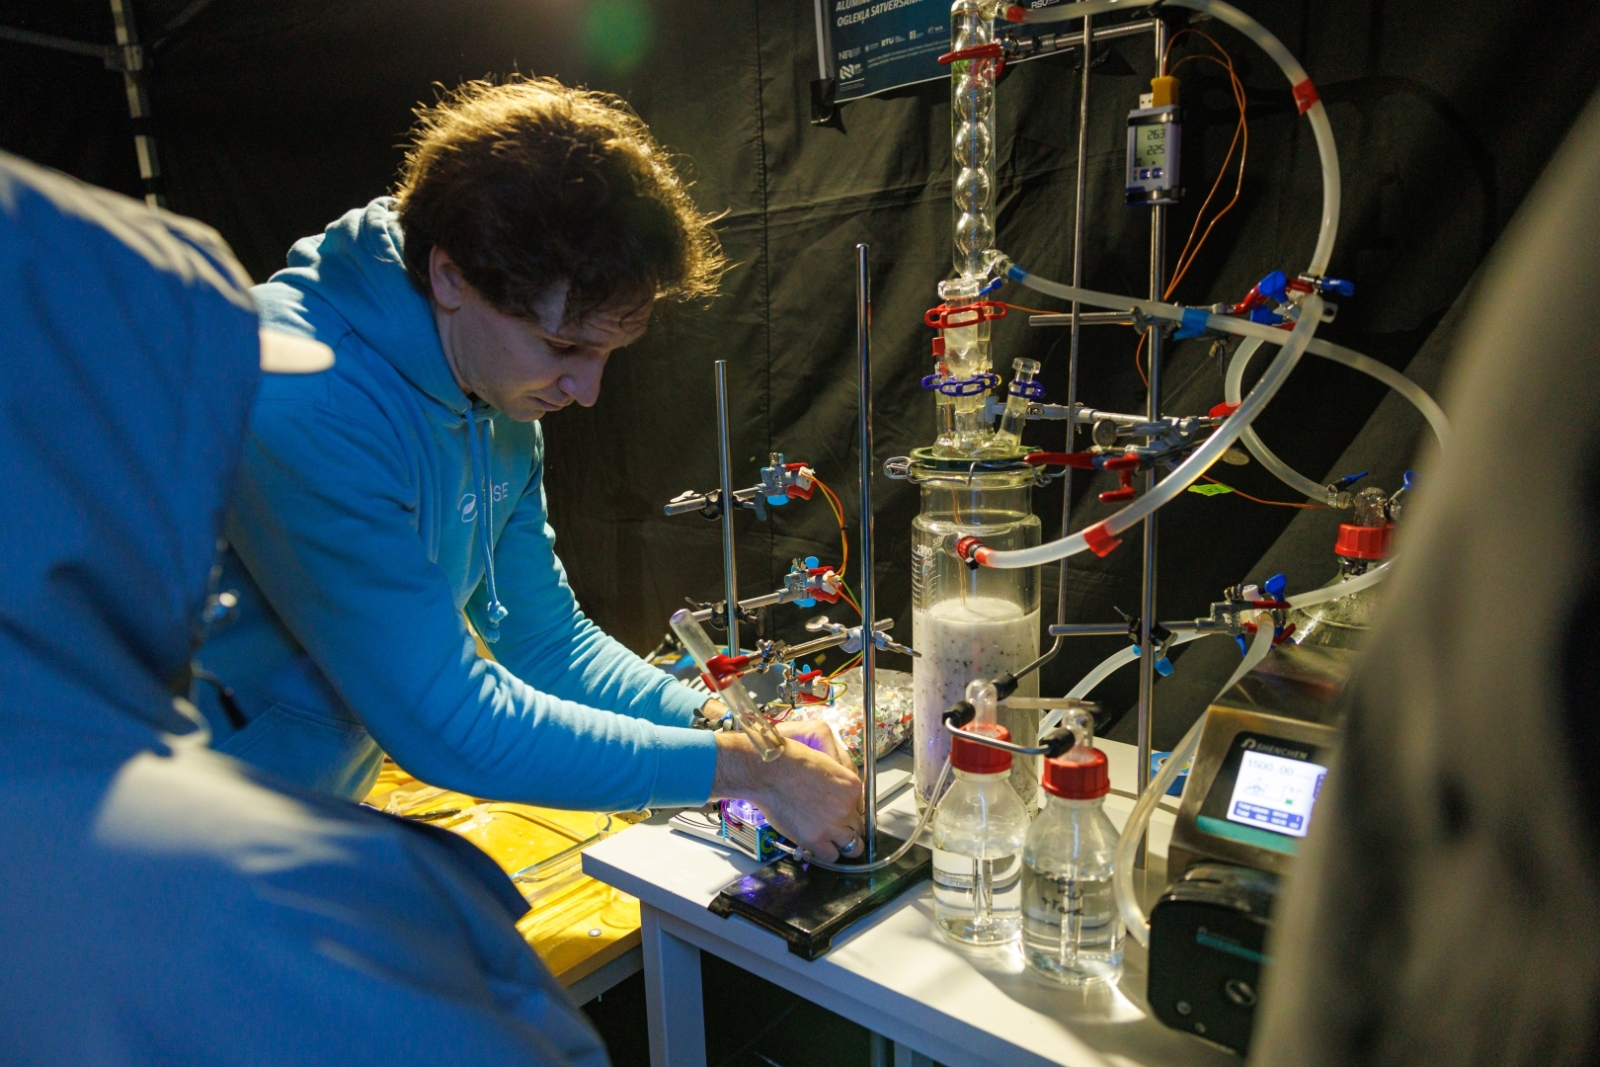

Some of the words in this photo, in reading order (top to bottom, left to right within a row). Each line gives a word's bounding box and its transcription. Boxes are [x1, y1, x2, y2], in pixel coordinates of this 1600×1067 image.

[1031, 0, 1048, 9] RSU
[837, 9, 869, 27] OGLEKĻA
[881, 38, 894, 47] RTU
[493, 482, 509, 502] SE
